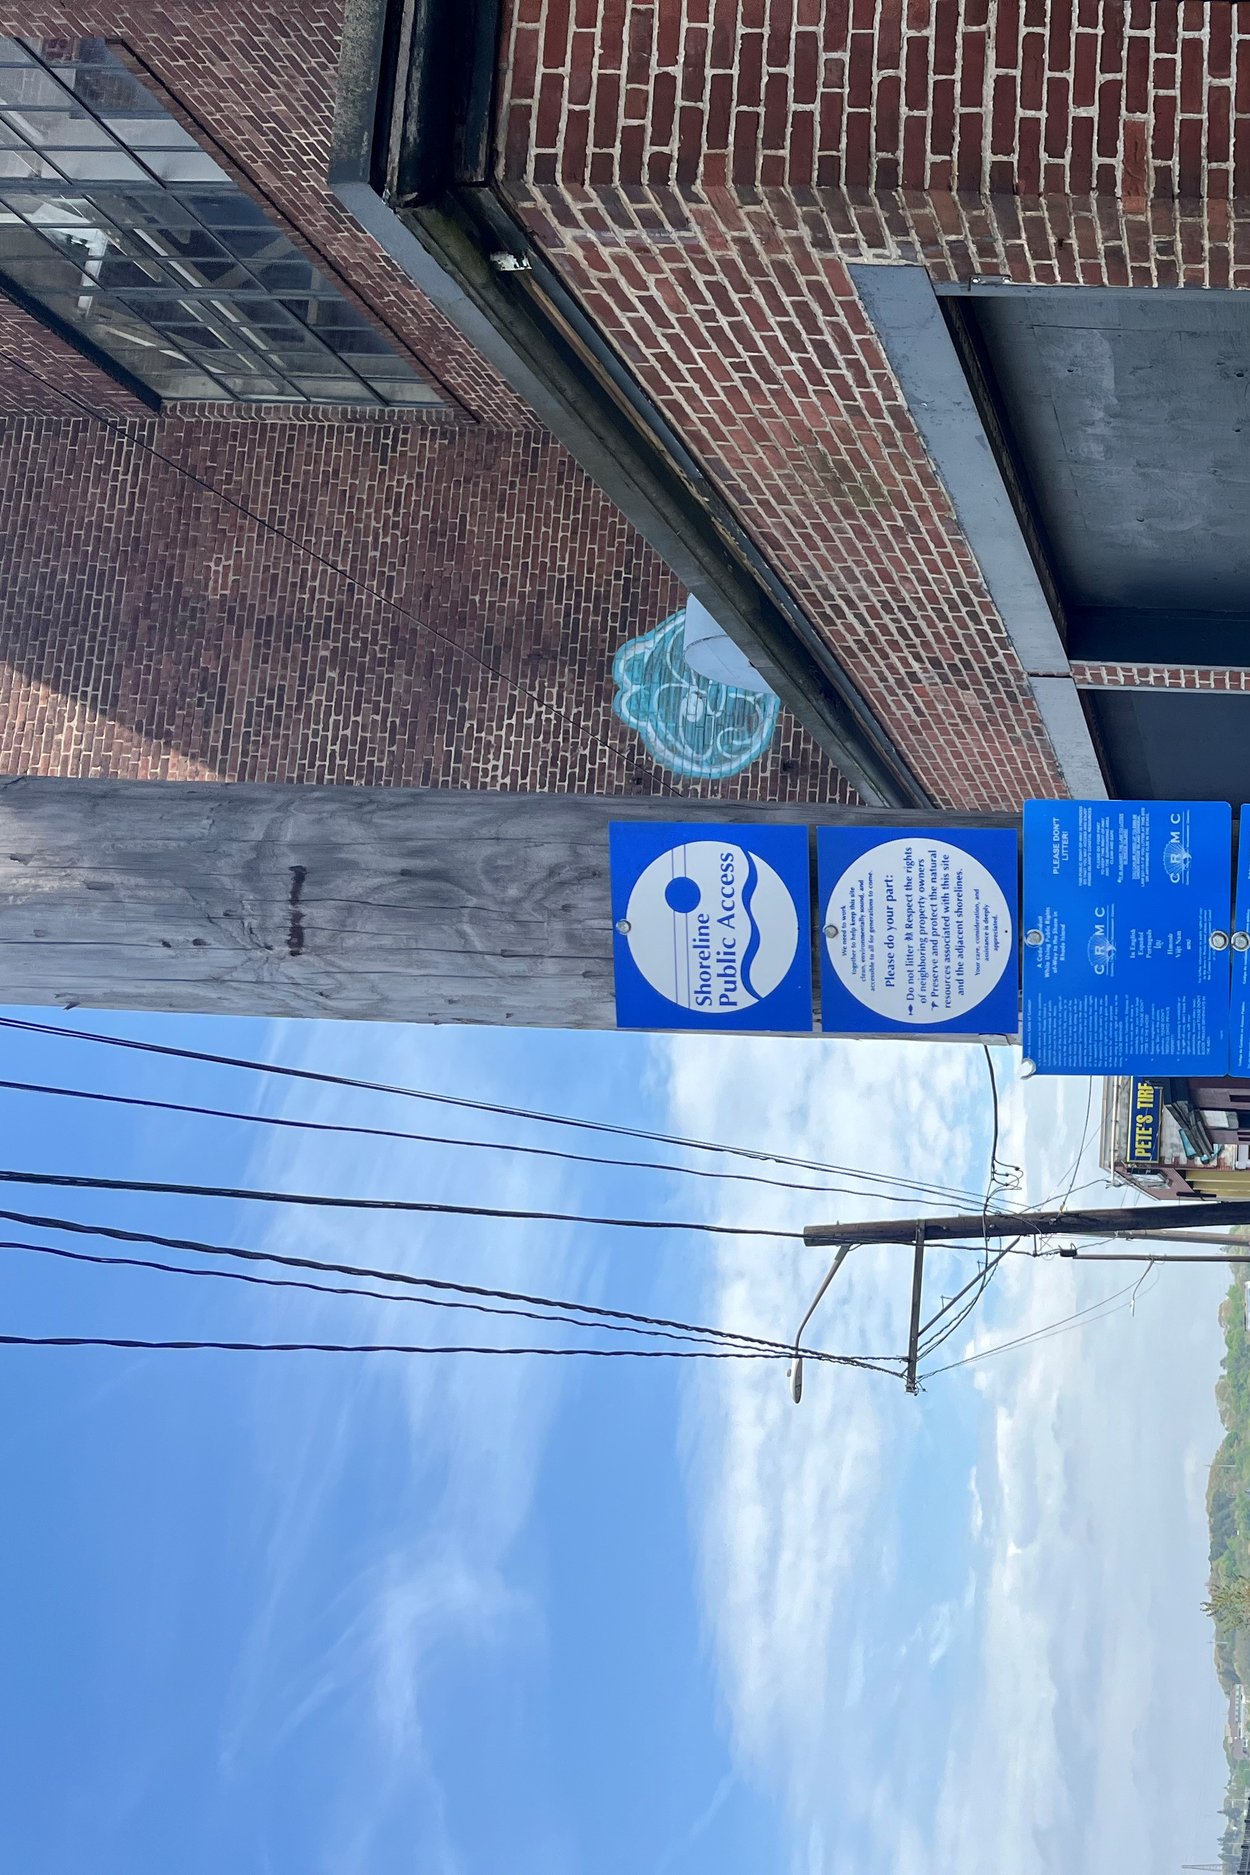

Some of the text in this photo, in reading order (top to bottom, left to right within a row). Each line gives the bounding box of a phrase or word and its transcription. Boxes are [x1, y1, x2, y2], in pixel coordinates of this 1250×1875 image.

[904, 847, 915, 873] rights
[1061, 831, 1069, 861] LITTER!
[941, 854, 949, 871] site
[904, 876, 913, 891] the
[941, 873, 950, 890] this
[868, 898, 876, 933] generations
[905, 894, 915, 929] Respect
[918, 896, 928, 935] property
[942, 893, 950, 913] with
[983, 904, 991, 924] deeply
[716, 852, 738, 1006] Public Access
[850, 927, 858, 940] help
[884, 874, 897, 987] Please do your part:
[928, 850, 940, 997] Preserve and protect the natural
[942, 916, 951, 963] associated
[954, 868, 966, 996] and the adjacent shorelines.
[992, 914, 1000, 951] appreciated.
[692, 913, 712, 1006] Shoreline
[841, 945, 848, 956] We
[905, 945, 914, 966] litter
[917, 937, 929, 991] neighboring
[906, 987, 914, 1001] Do
[918, 994, 927, 1004] of
[1135, 1114, 1153, 1157] PETE'S
